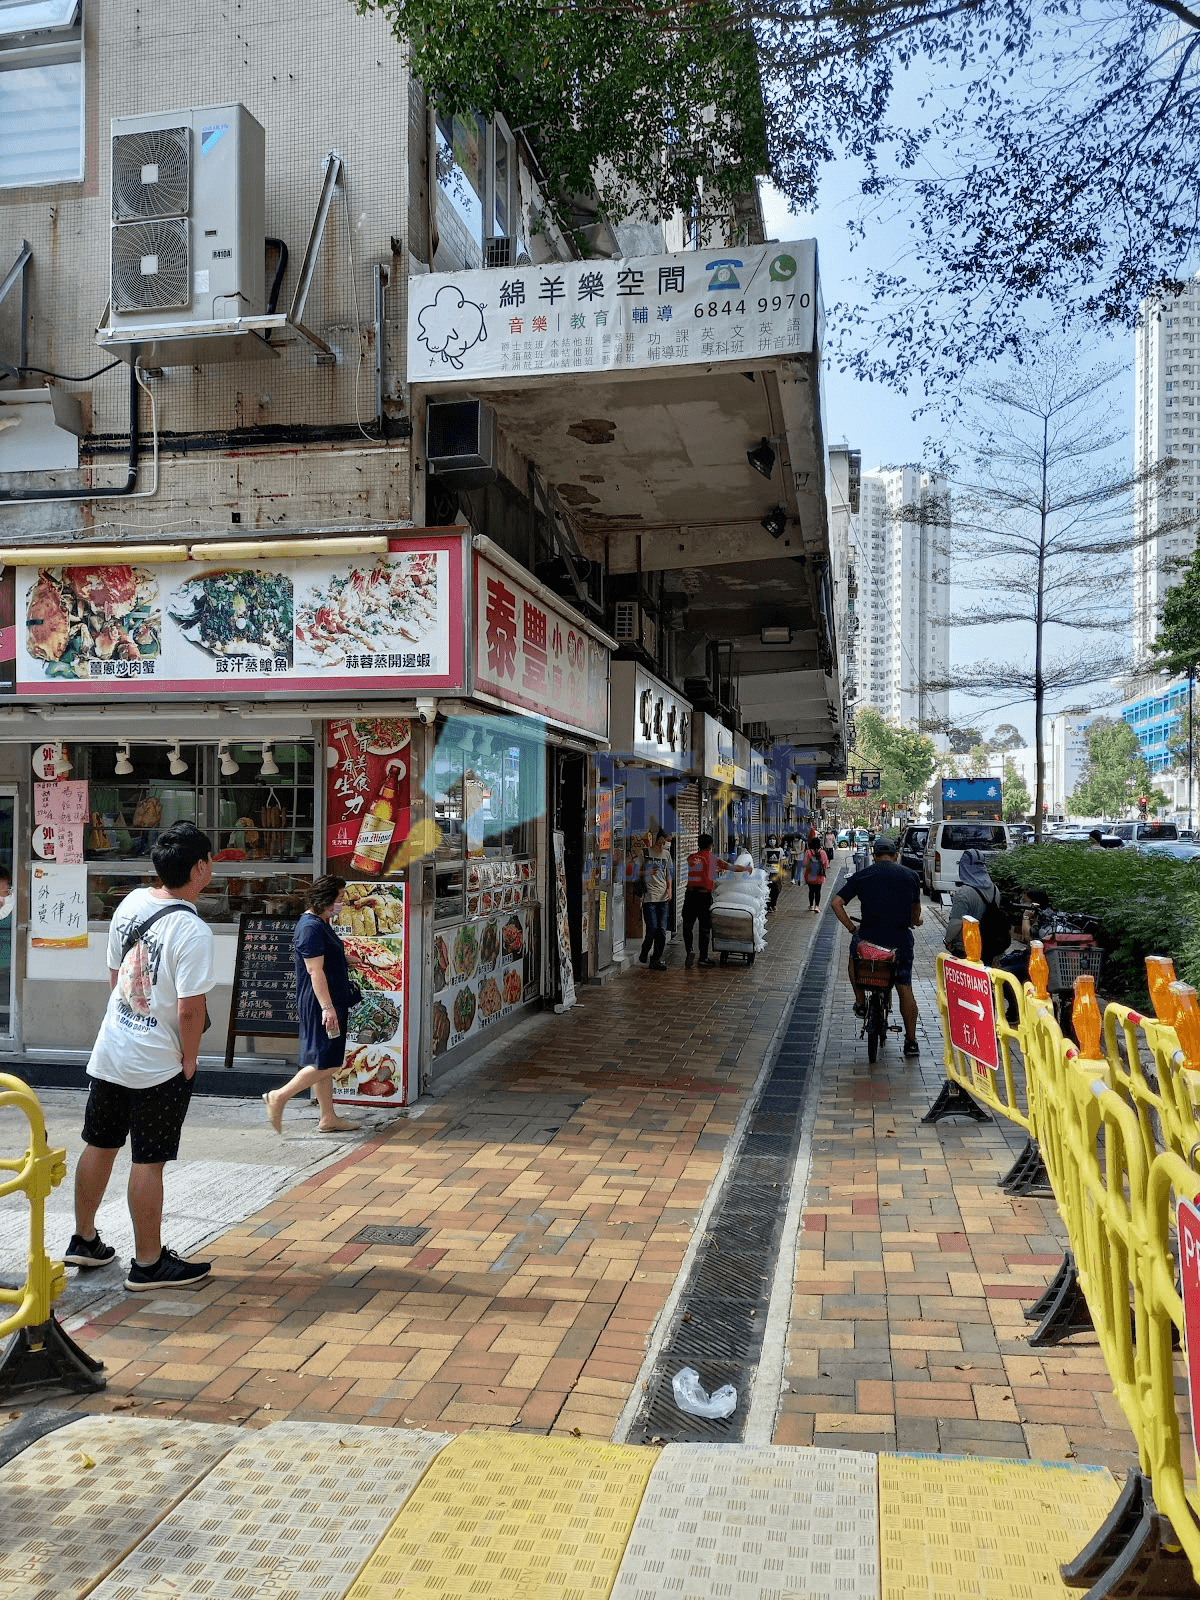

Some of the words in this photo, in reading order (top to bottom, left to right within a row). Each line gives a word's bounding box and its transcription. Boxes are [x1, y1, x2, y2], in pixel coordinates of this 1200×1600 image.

[499, 265, 685, 309] 綿羊樂空間
[508, 315, 548, 335] 音樂
[570, 309, 609, 330] 教育
[632, 304, 673, 324] 輔導
[694, 301, 746, 318] 6844
[757, 293, 810, 313] 9970
[647, 329, 689, 345] 功課
[701, 325, 744, 341] 英文
[758, 317, 800, 336] 英語
[647, 344, 689, 361] 輔導班
[701, 340, 744, 356] 專科班
[758, 333, 801, 351] 拼音班
[486, 576, 548, 697] 泰豐
[345, 653, 431, 669] 蒜蓉蒸開邊蝦
[42, 827, 55, 856] 外賣
[38, 884, 50, 924] 外賣
[51, 893, 67, 923] 一律
[66, 891, 85, 928] 九折
[944, 965, 989, 996] PEDESTRIANS
[962, 1022, 980, 1049] 行人
